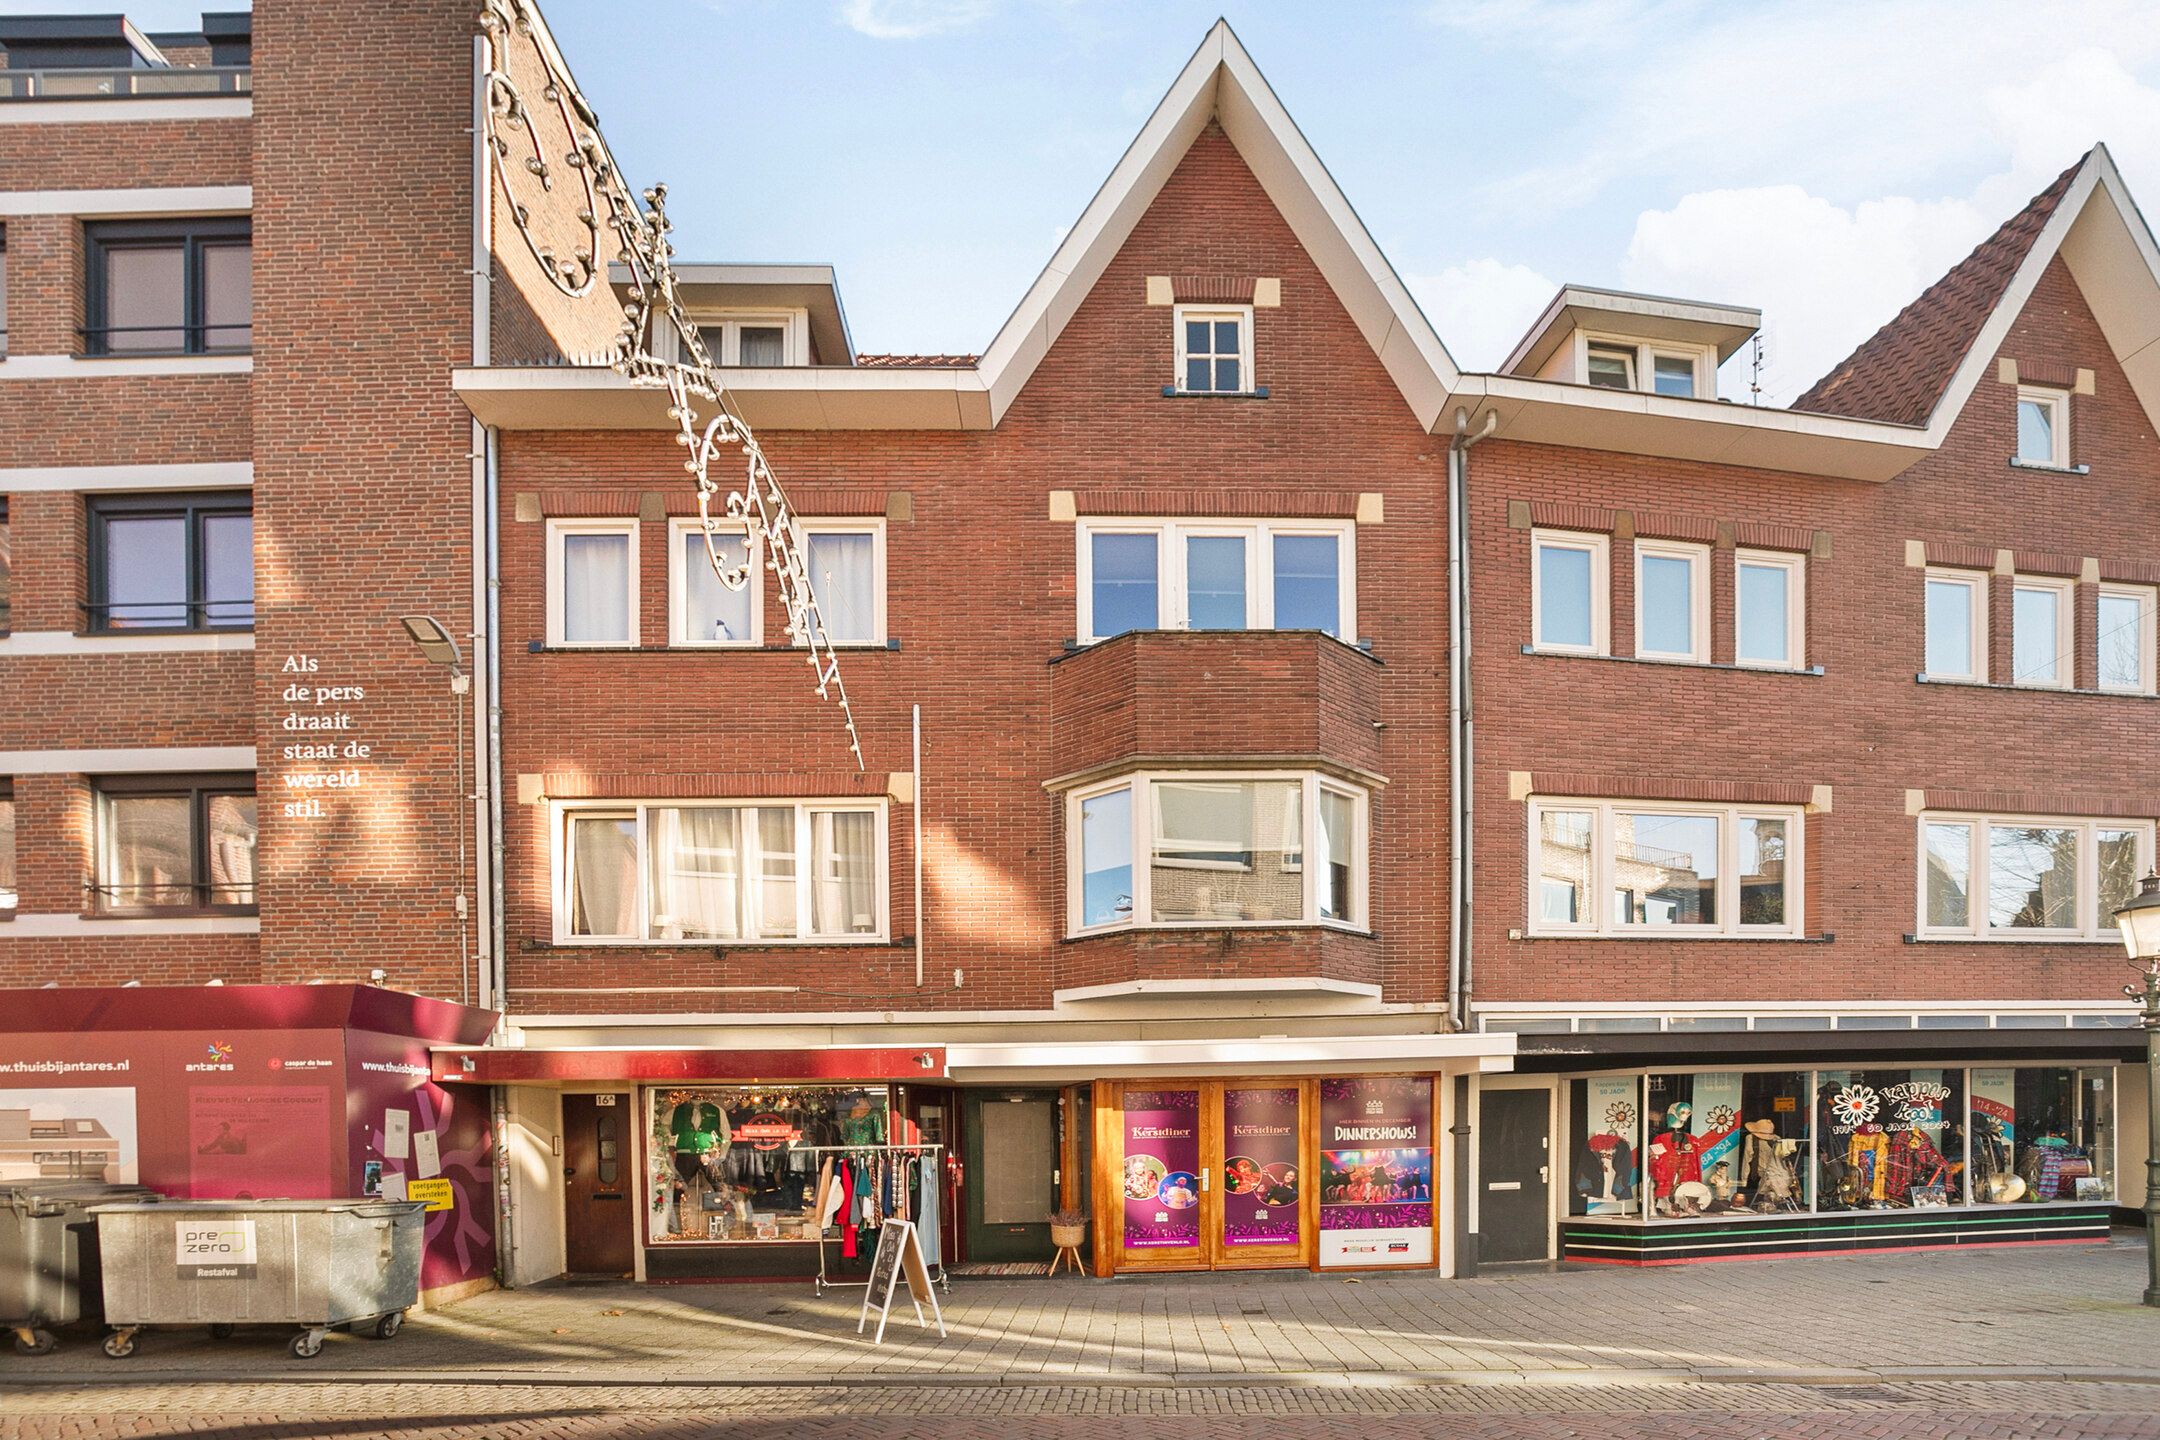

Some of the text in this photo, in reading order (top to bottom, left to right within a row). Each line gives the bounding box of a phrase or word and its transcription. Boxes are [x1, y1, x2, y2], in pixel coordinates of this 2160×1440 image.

[281, 654, 319, 672] Als
[282, 683, 364, 705] de pers
[282, 711, 351, 730] draait
[283, 740, 370, 759] staat de
[282, 769, 361, 788] wereld
[284, 799, 327, 817] stil.
[185, 1062, 234, 1071] antares
[1132, 1126, 1191, 1137] Kerstdiner
[1233, 1125, 1291, 1135] Kerstdiner
[1866, 1123, 1883, 1133] 50
[1885, 1122, 1915, 1132] JAOR
[1921, 1120, 1951, 1130] 2024
[1334, 1126, 1416, 1141] DINNERSHOWS!
[412, 1181, 449, 1191] voetgangers
[414, 1190, 448, 1199] oversteken
[185, 1231, 218, 1243] pre
[184, 1243, 231, 1253] zero
[196, 1267, 238, 1277] Restafval
